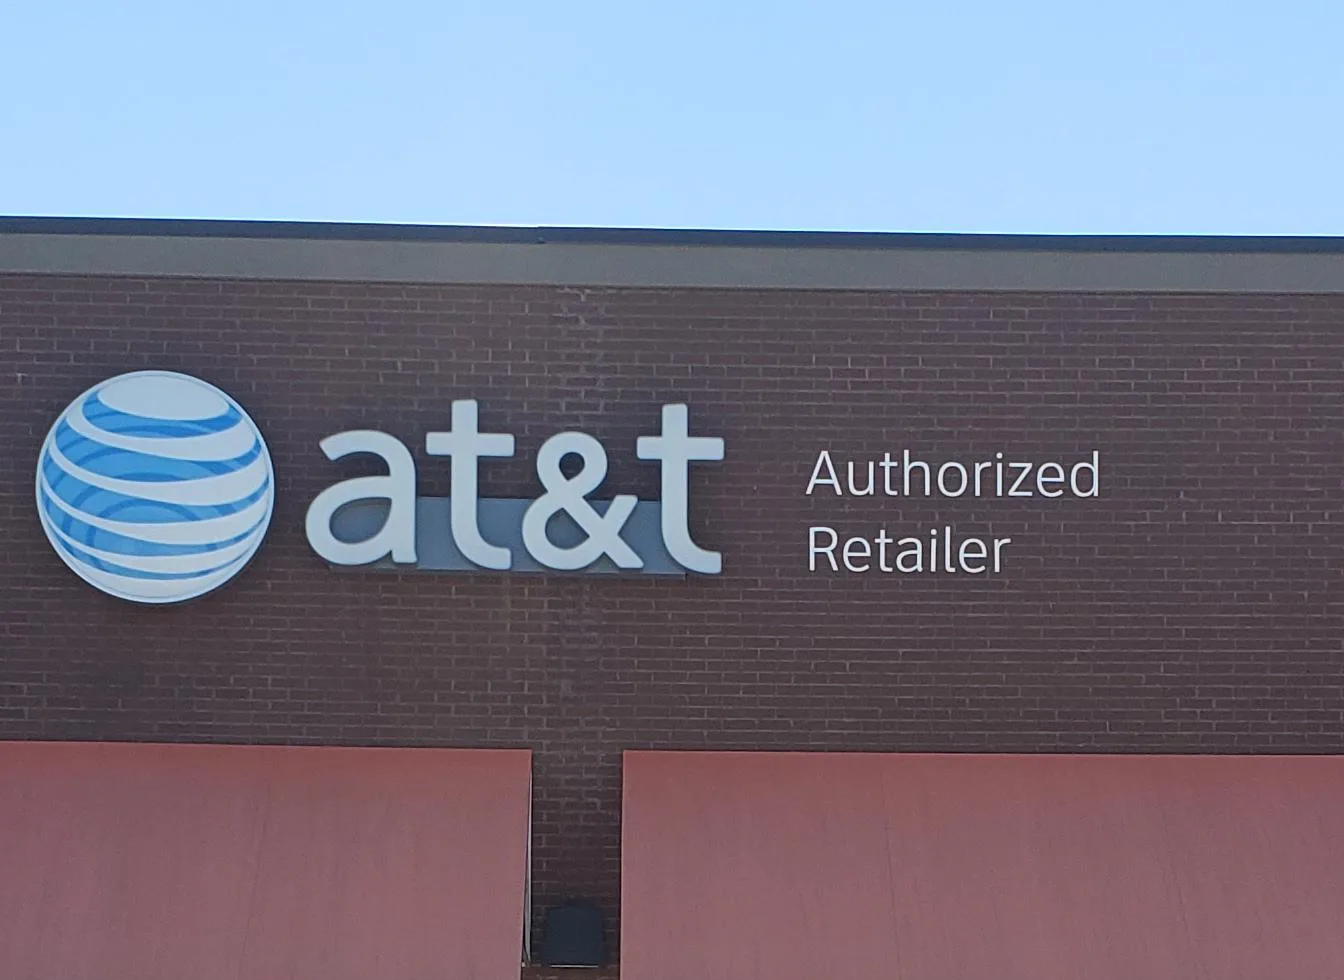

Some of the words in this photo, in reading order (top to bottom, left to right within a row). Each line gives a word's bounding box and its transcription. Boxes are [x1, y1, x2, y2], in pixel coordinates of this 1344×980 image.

[304, 399, 725, 575] at&t
[805, 449, 1100, 498] Authorized
[808, 525, 1012, 573] Retailer
